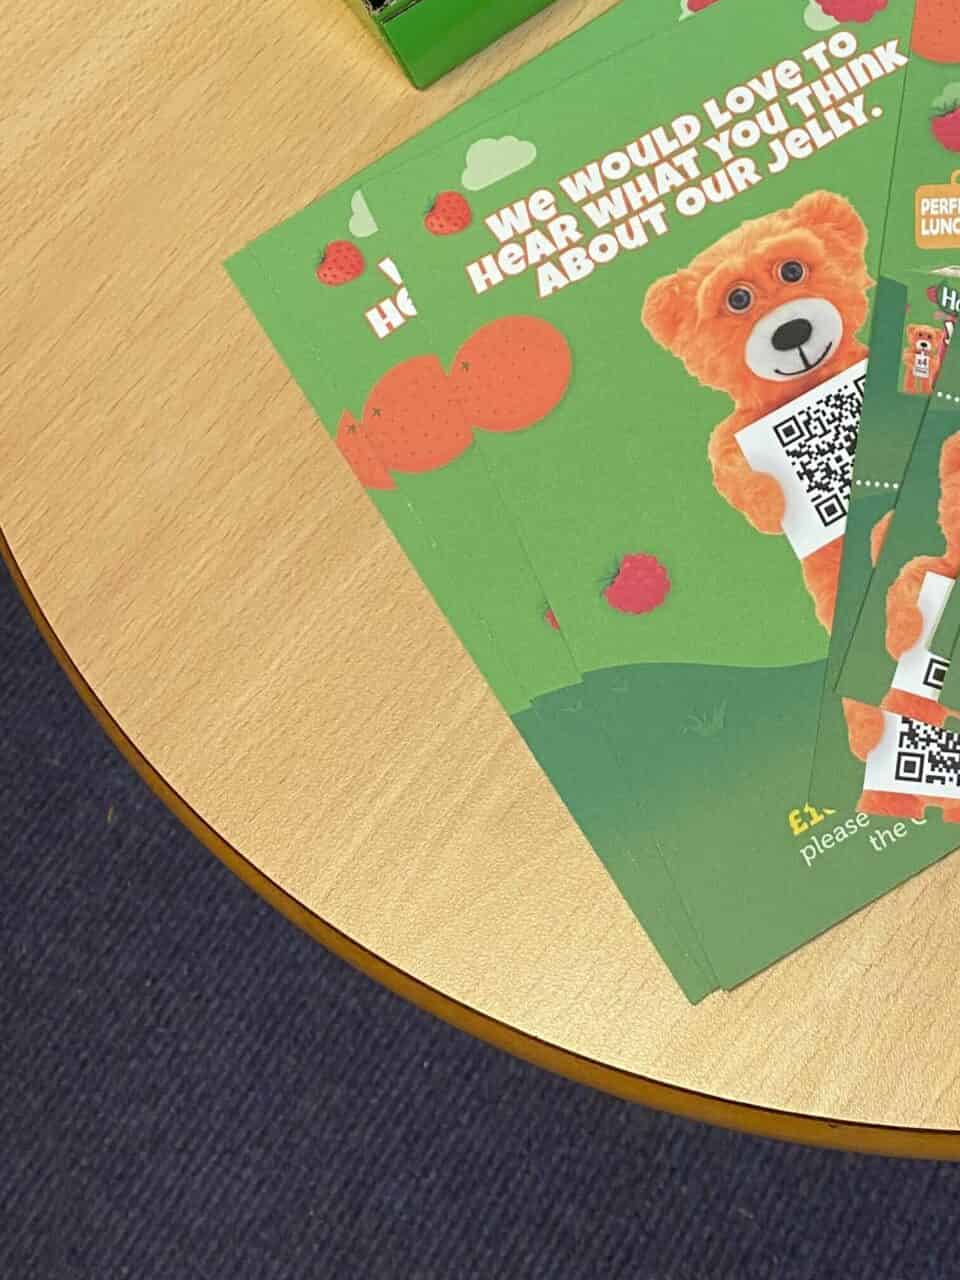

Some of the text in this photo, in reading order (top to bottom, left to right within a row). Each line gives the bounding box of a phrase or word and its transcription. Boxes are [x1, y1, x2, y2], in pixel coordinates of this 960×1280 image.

[560, 114, 702, 204] WOULD
[803, 30, 858, 74] TO
[583, 145, 704, 231] WHAT
[703, 101, 789, 161] YOU
[536, 205, 669, 299] ABOUT
[675, 156, 762, 217] OUR
[800, 811, 870, 867] please
[869, 822, 908, 852] the
